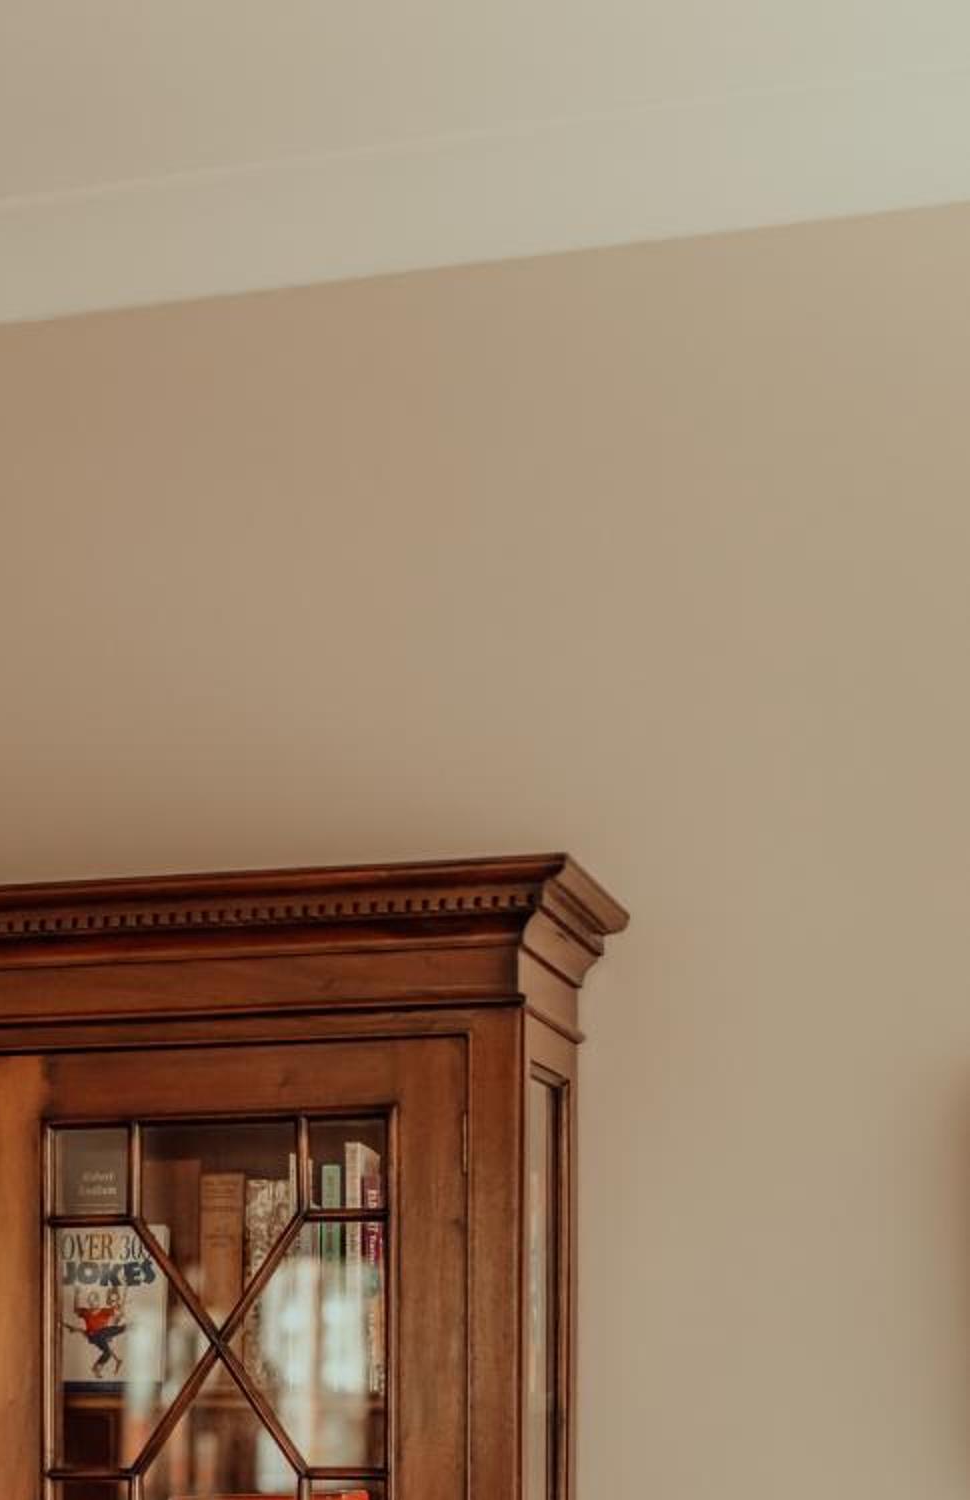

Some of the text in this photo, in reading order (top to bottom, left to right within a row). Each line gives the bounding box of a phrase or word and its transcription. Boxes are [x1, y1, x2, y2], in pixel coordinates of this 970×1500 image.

[61, 1234, 150, 1261] OVER 30
[62, 1261, 156, 1287] JOKES
